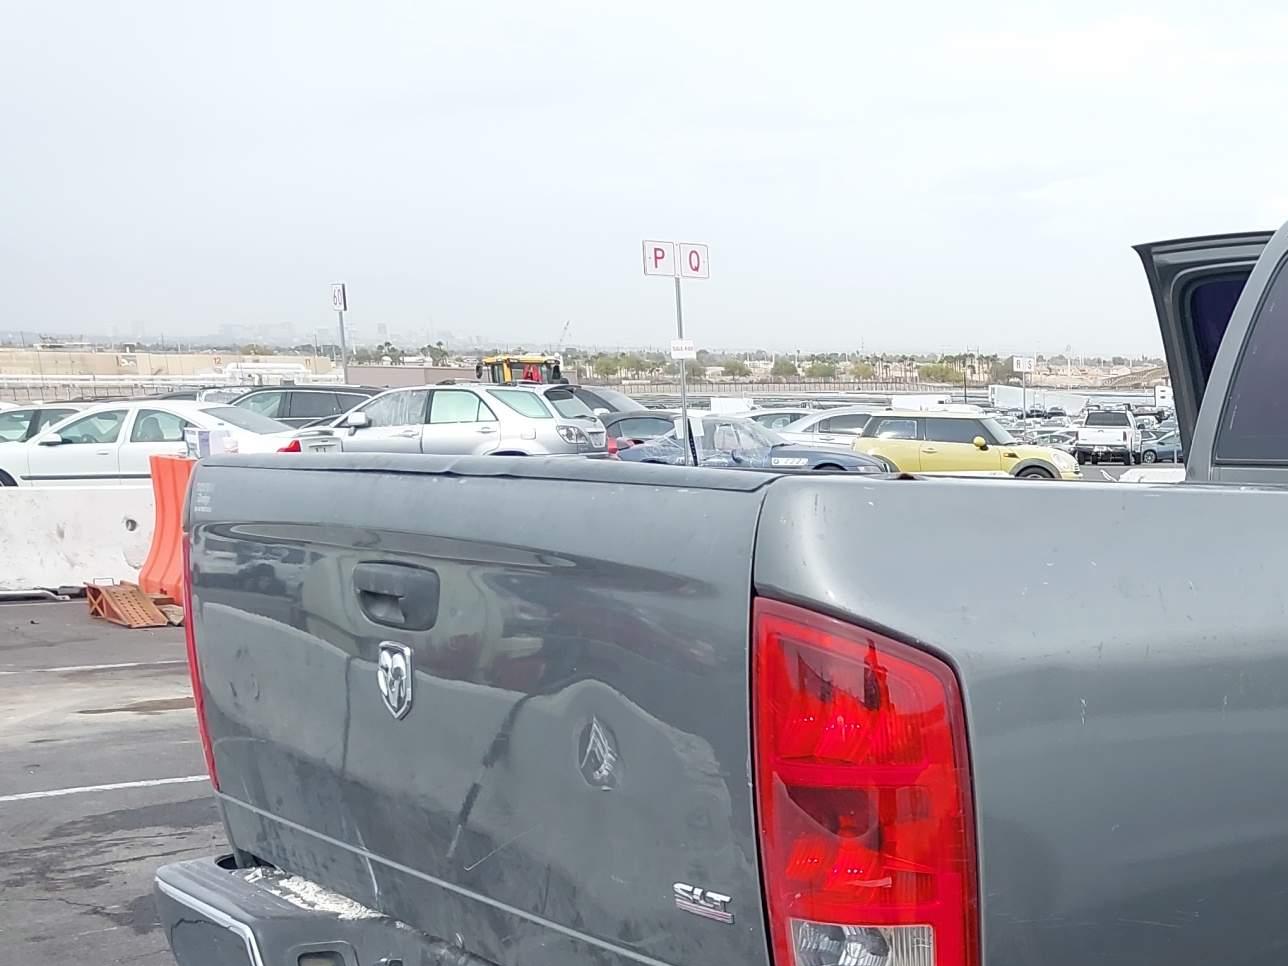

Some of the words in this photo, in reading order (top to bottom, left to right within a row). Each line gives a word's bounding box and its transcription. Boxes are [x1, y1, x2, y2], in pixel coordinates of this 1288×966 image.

[653, 247, 665, 269] P
[689, 249, 700, 272] Q
[672, 882, 732, 913] SLT
